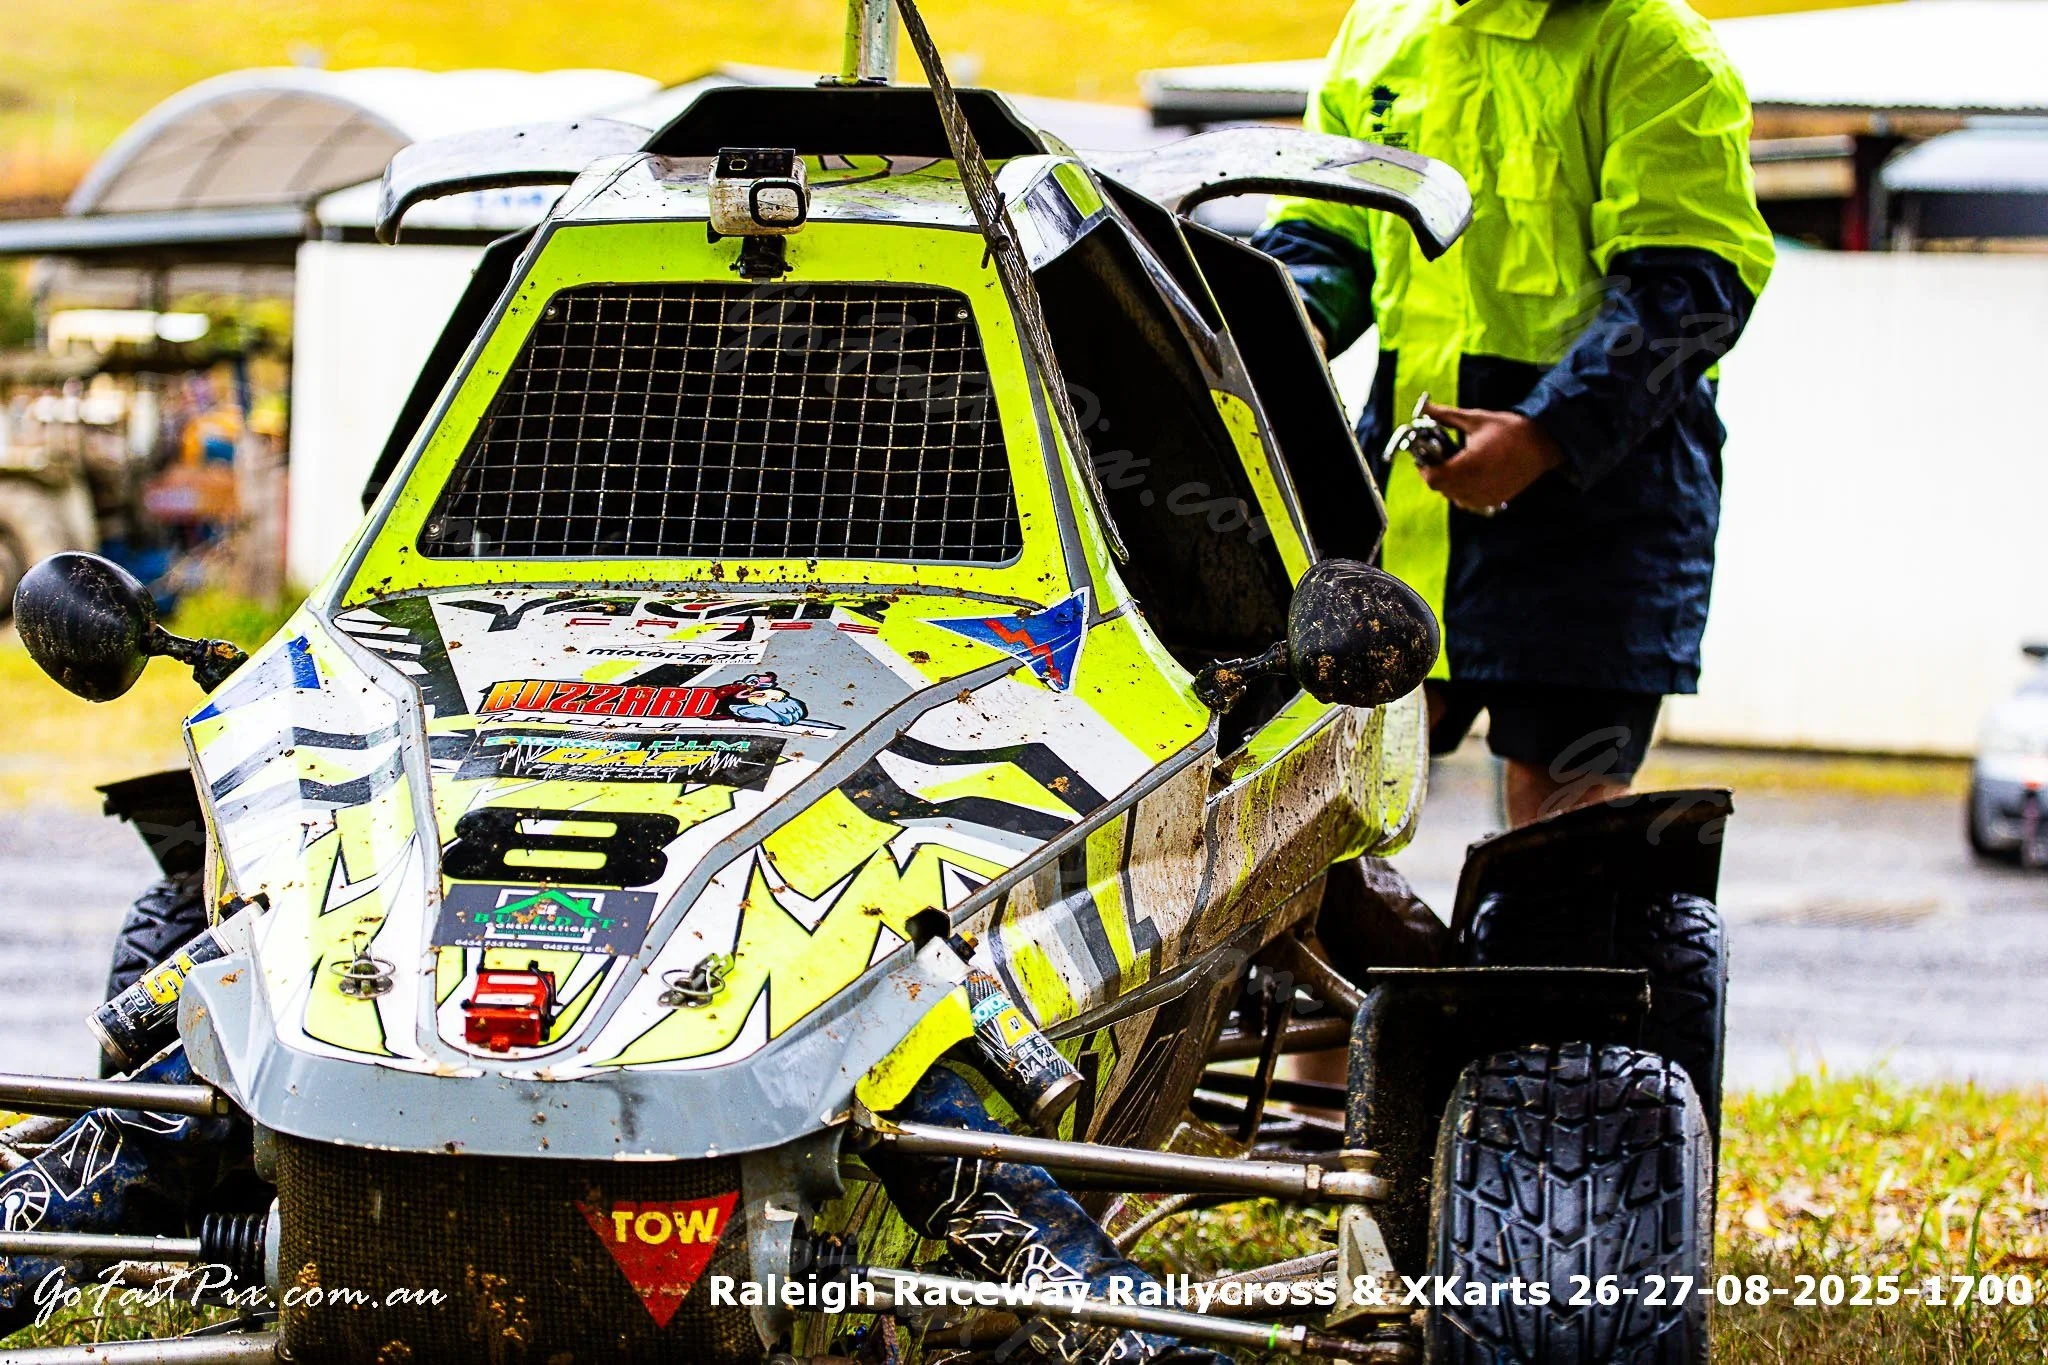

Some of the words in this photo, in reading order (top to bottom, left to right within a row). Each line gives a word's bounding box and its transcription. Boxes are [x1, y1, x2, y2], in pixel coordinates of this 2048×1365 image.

[587, 648, 759, 664] motorsport
[480, 681, 718, 718] BUZZARD
[477, 712, 683, 732] Racing
[442, 807, 680, 888] 8
[610, 1207, 720, 1245] TOW
